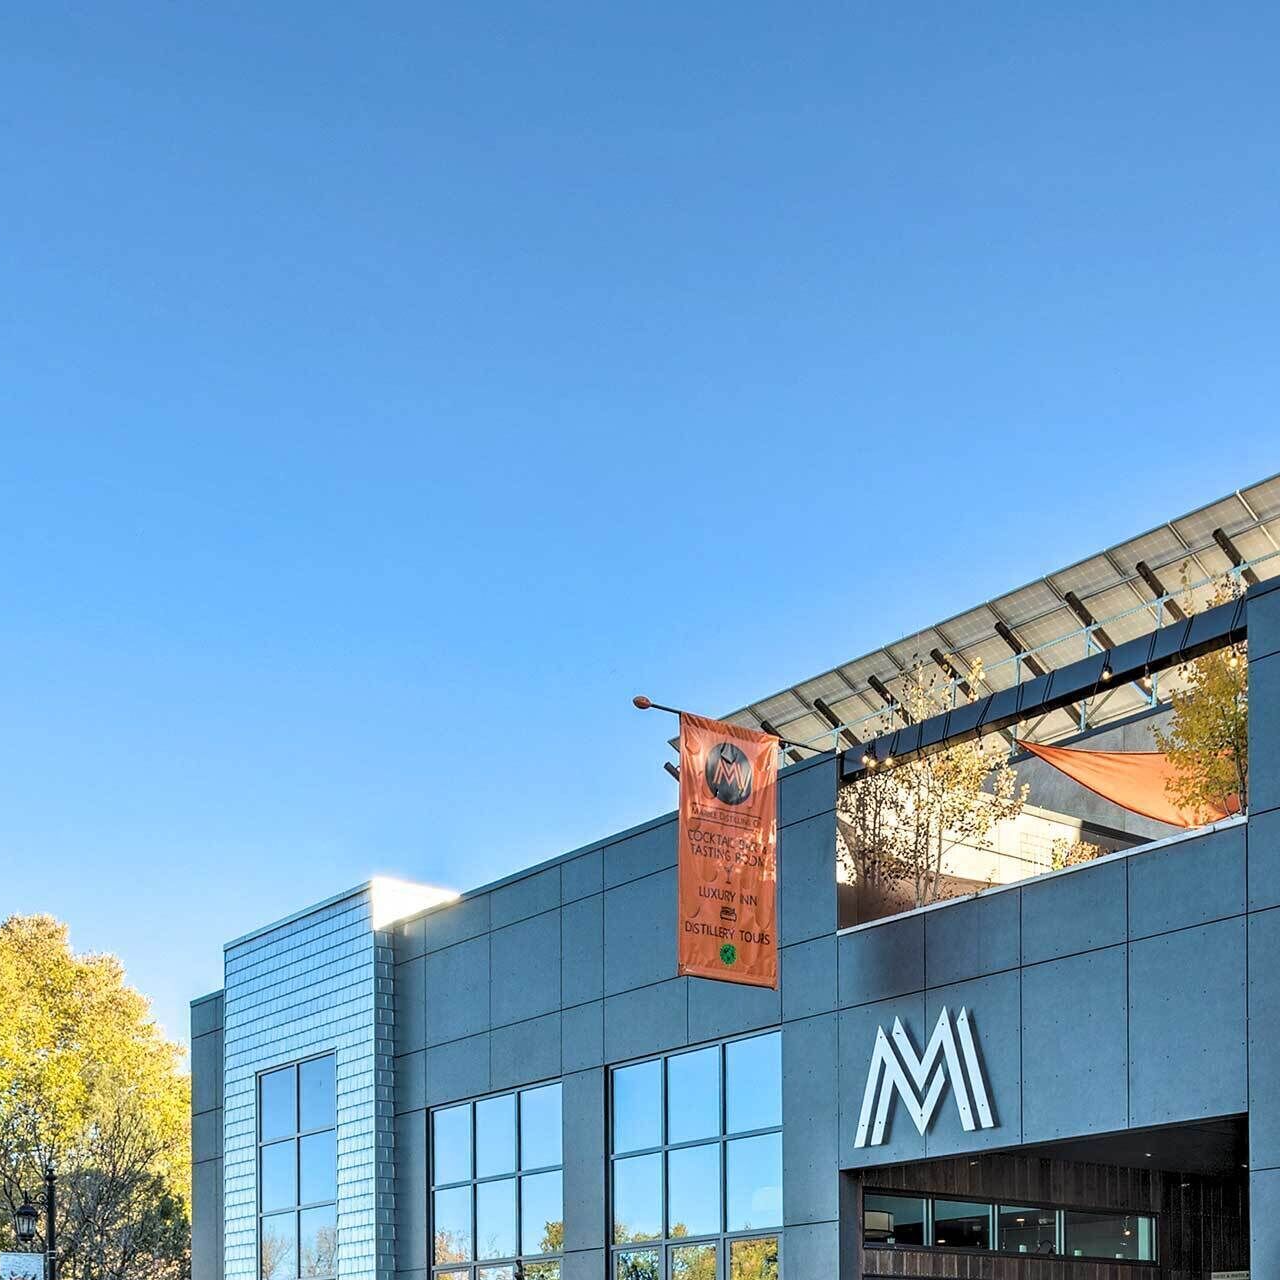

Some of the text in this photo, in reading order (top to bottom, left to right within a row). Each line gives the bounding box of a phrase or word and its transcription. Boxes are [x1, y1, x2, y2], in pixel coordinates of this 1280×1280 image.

[688, 829, 735, 849] COCKTAIL
[690, 843, 731, 861] TASTING
[699, 885, 758, 906] LUXURY INN
[685, 920, 770, 945] DISTILLERY TOURS
